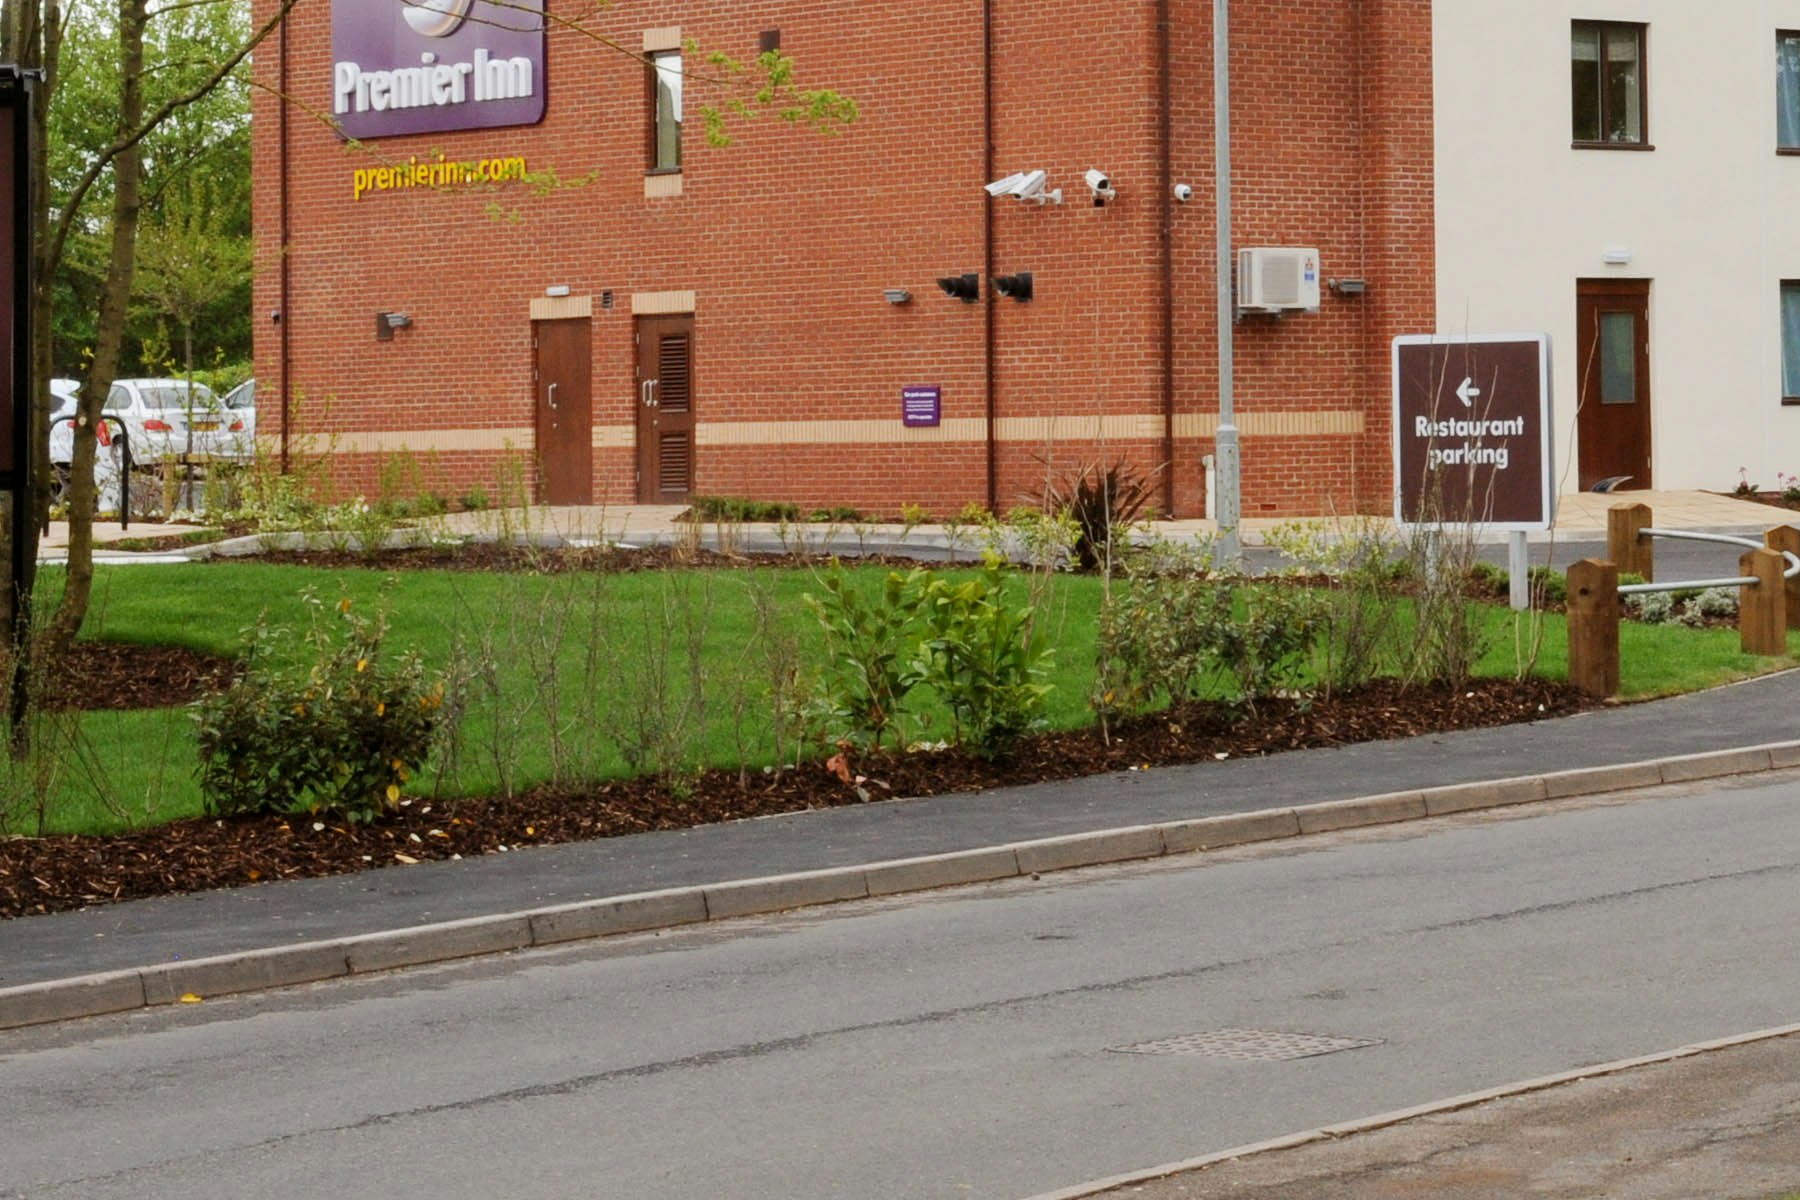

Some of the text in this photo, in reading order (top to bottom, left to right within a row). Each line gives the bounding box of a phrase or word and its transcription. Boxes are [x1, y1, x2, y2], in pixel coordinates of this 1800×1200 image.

[334, 48, 533, 114] Premier Inn
[1415, 415, 1524, 437] Restaurant
[1429, 441, 1509, 470] parking
